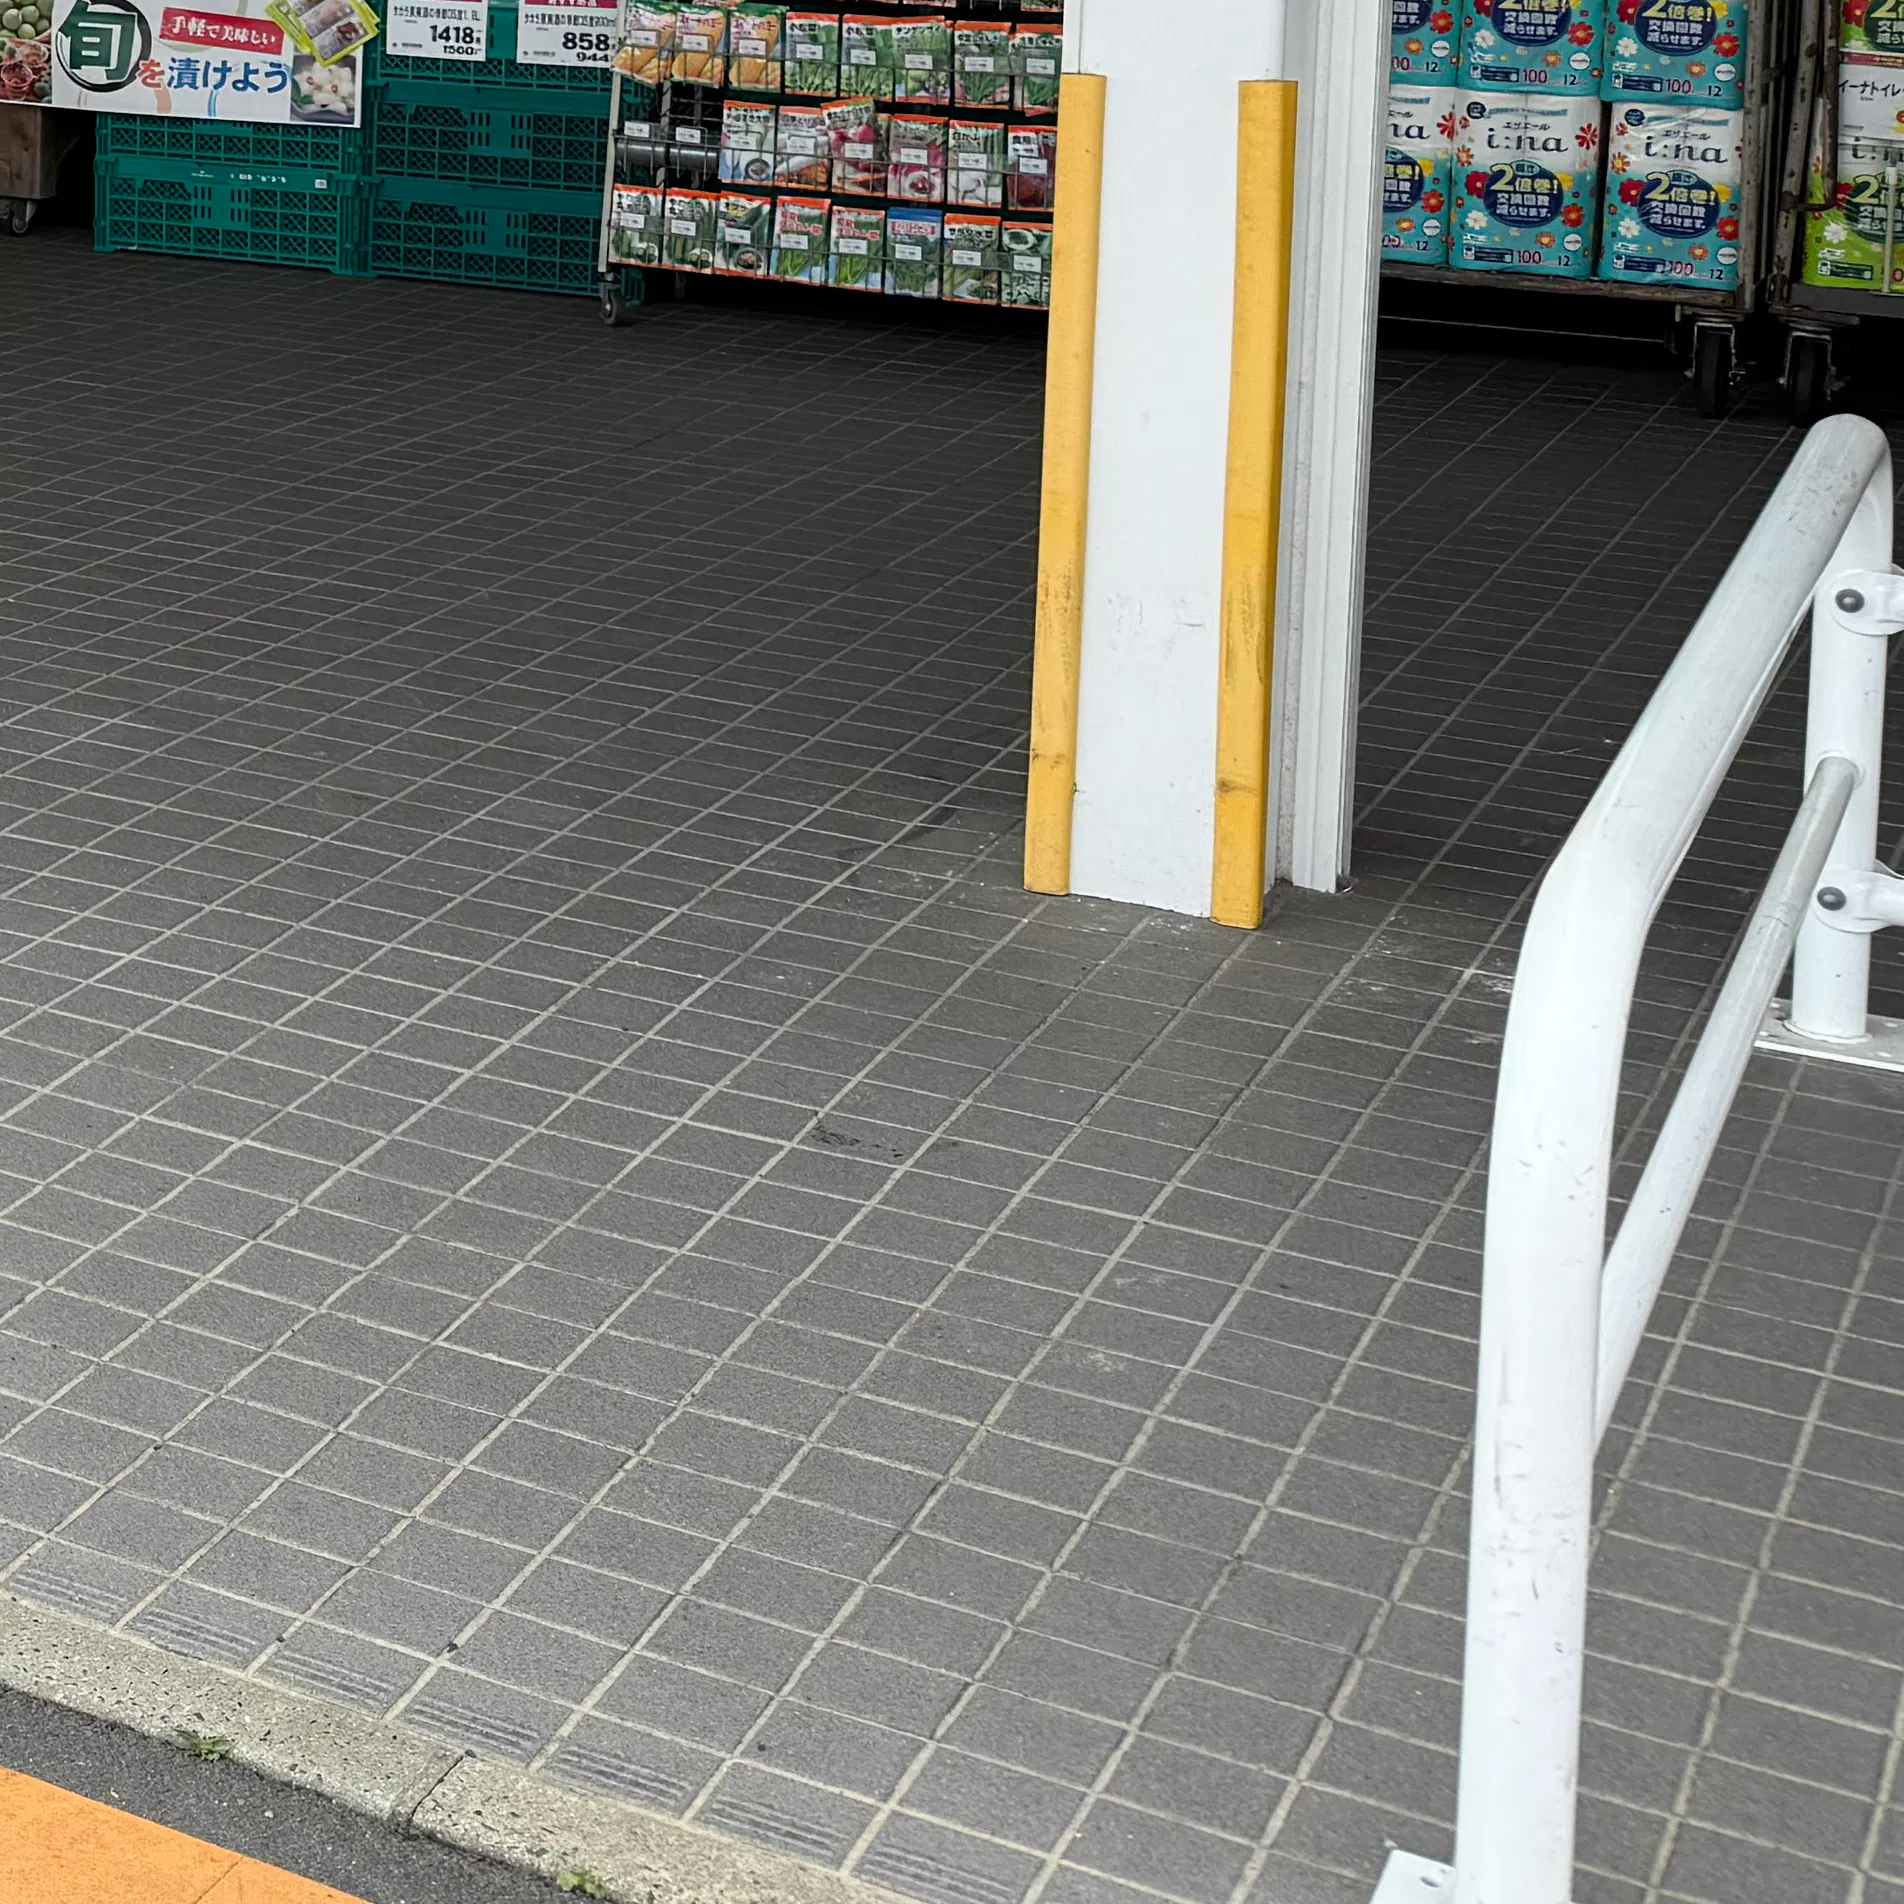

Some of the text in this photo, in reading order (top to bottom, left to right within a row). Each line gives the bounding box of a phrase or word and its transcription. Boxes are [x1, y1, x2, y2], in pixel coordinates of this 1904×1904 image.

[169, 12, 278, 48] 手軽で美味しい
[429, 24, 475, 45] 1418
[562, 31, 610, 52] 858
[576, 51, 610, 63] 944
[1425, 61, 1439, 73] 12
[135, 56, 290, 95] を漬けよう
[1523, 69, 1548, 84] 100
[1563, 74, 1578, 85] 12
[1665, 79, 1691, 94] 100
[1707, 85, 1722, 97] 12
[1839, 80, 1904, 97] イーナトイレ
[1487, 128, 1568, 153] i:na
[1645, 135, 1728, 164] i:na
[1517, 250, 1542, 264] 100
[1558, 255, 1571, 267] 12
[1710, 268, 1724, 280] 12
